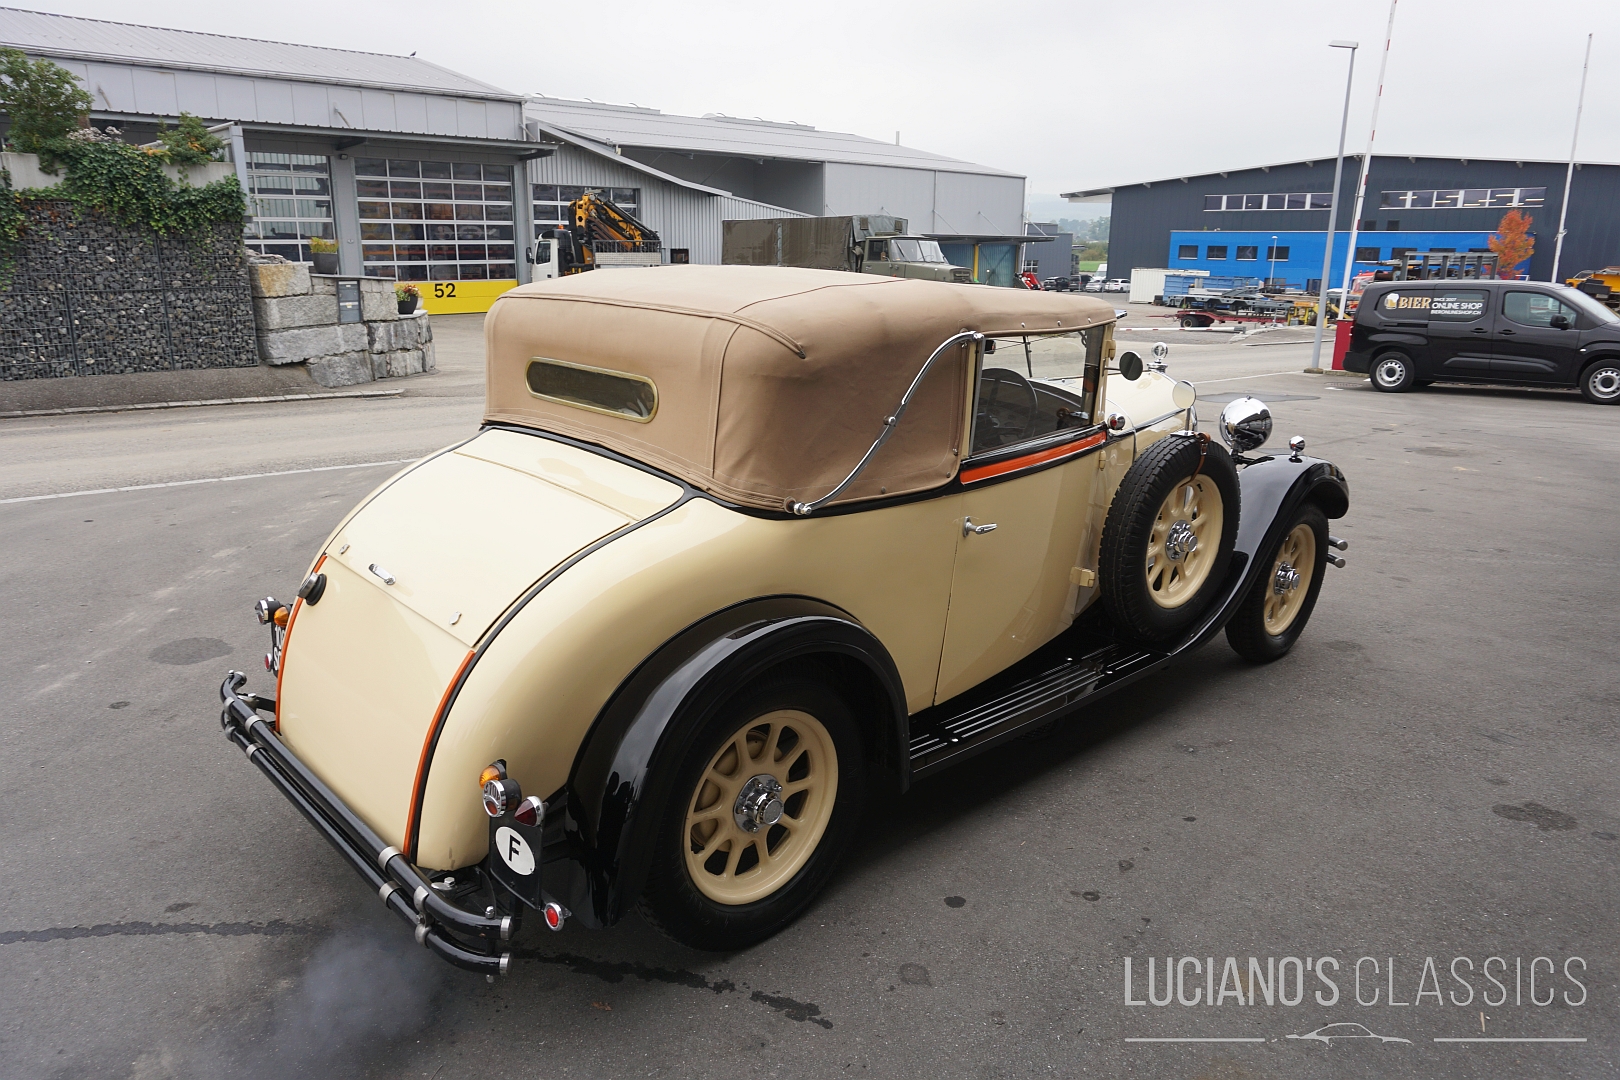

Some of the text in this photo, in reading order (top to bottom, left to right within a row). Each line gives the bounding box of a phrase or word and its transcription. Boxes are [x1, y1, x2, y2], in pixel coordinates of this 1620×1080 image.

[434, 283, 456, 298] 52
[1398, 297, 1432, 309] BIER
[508, 834, 521, 862] F
